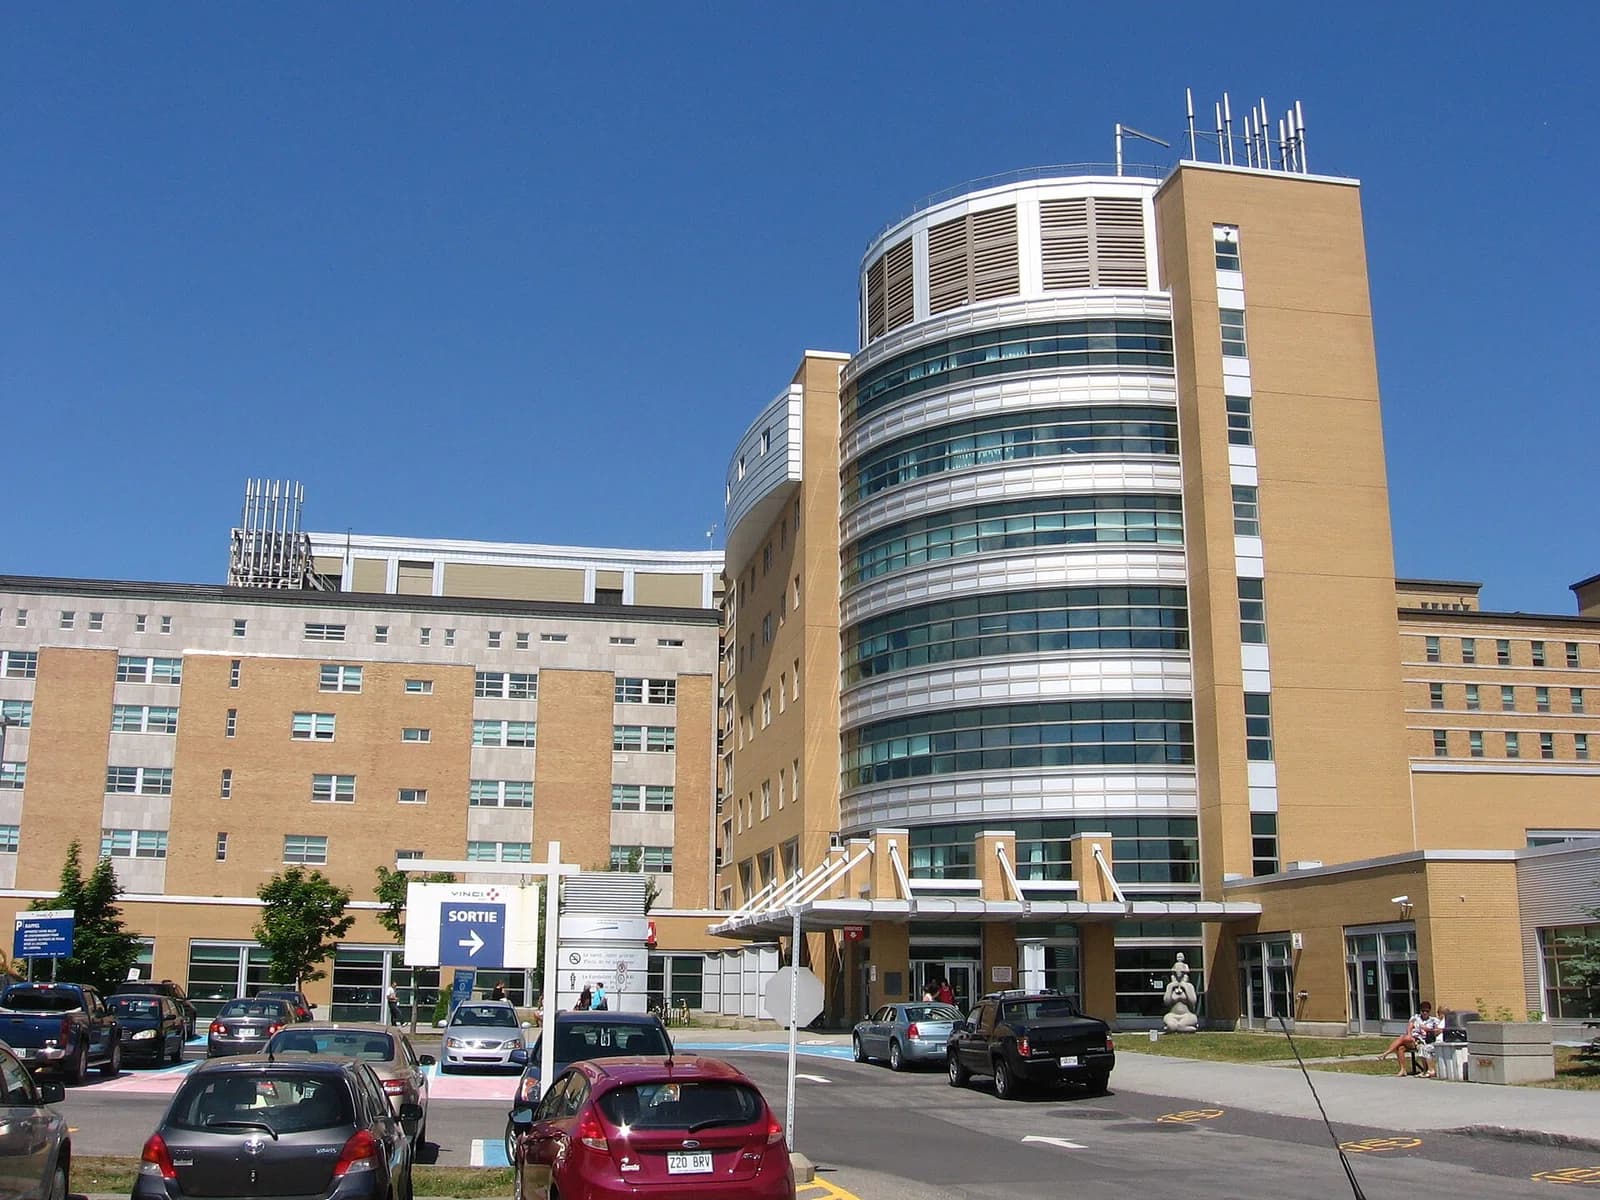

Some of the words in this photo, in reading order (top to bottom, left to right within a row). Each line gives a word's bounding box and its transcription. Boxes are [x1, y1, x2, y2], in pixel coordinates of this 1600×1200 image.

[448, 910, 498, 923] SORTIE
[16, 920, 22, 931] P
[670, 1156, 688, 1169] Z20
[692, 1155, 710, 1168] BRV
